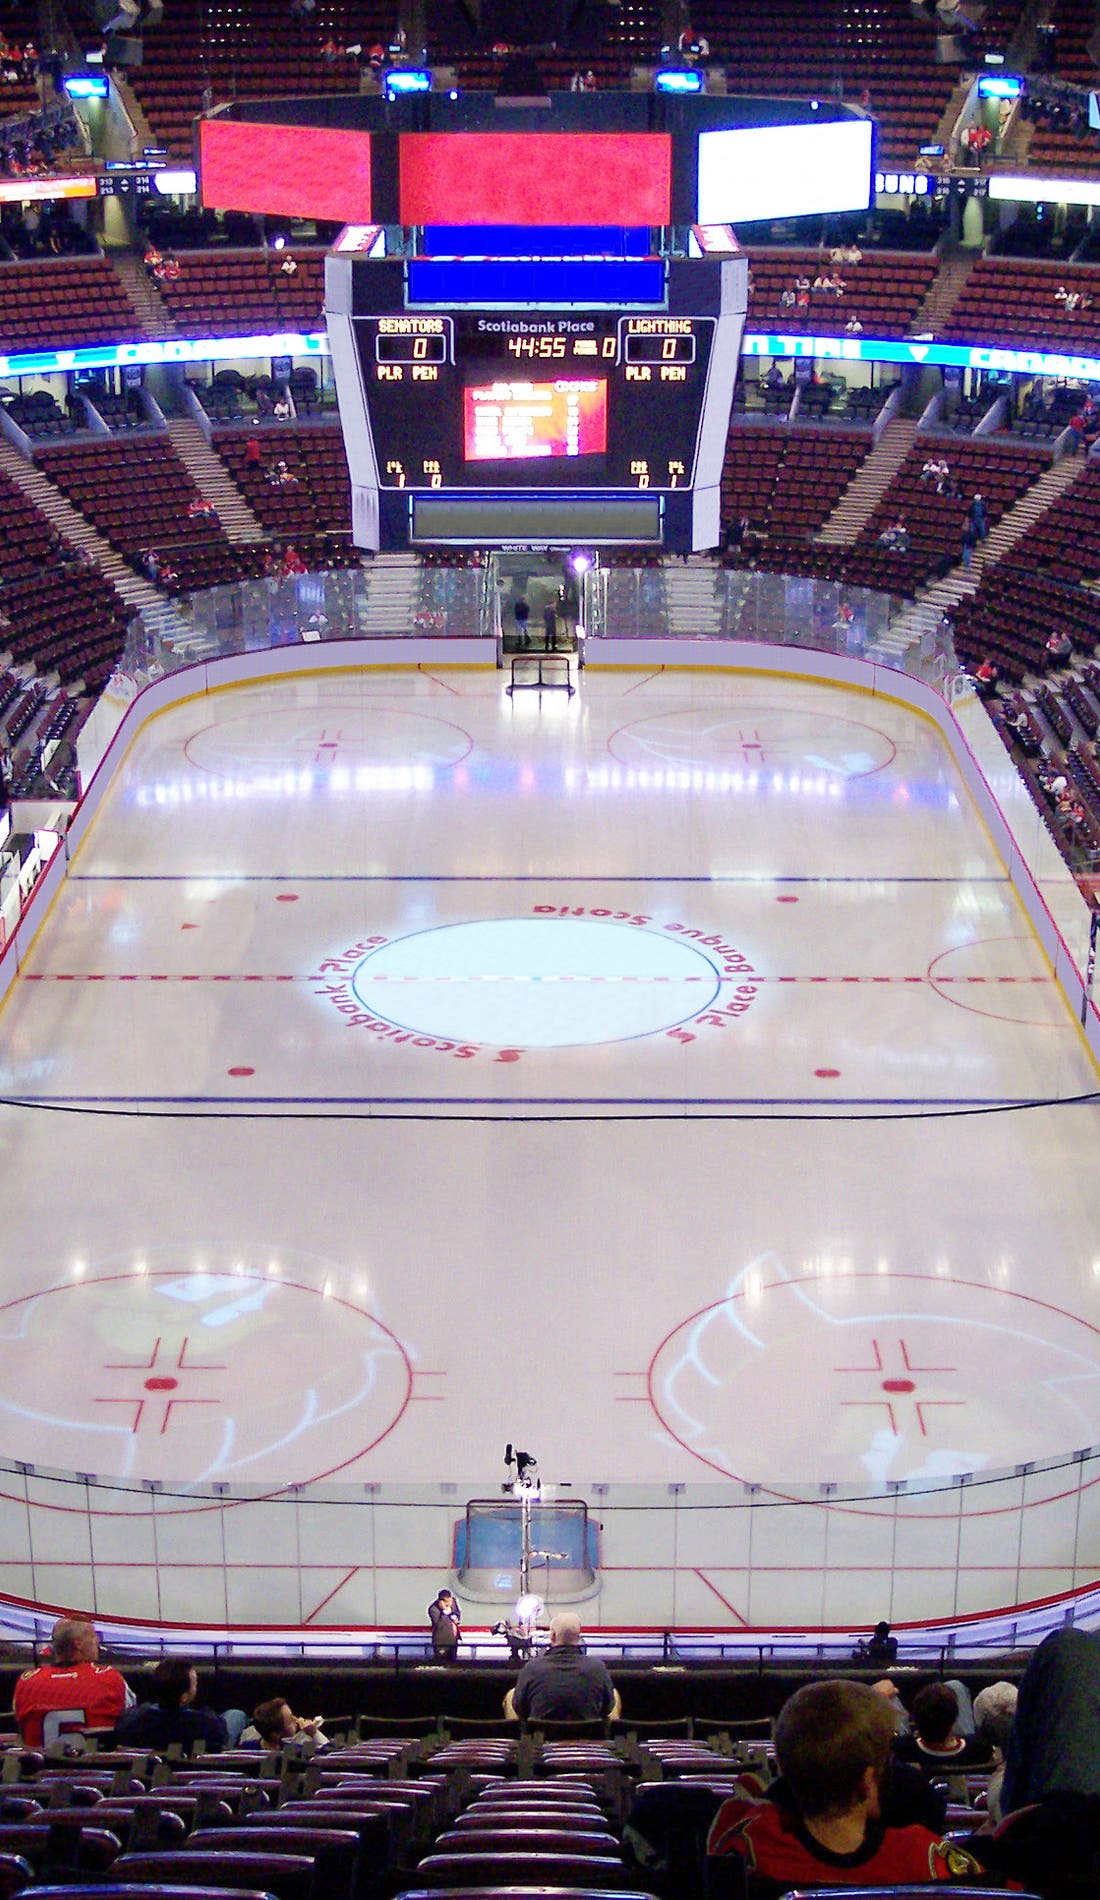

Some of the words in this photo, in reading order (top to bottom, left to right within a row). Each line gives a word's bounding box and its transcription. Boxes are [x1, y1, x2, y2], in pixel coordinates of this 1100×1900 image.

[378, 319, 444, 334] SENATORS
[478, 319, 555, 334] Scotiabank
[558, 320, 596, 333] Place
[413, 337, 428, 359] 0
[508, 337, 567, 358] 44:55
[601, 337, 617, 358] 0
[662, 337, 677, 359] 0
[377, 365, 403, 381] PLR
[625, 366, 652, 381] PLR
[660, 366, 687, 381] PEN
[533, 905, 652, 926] Scotia
[319, 936, 388, 972] Place
[664, 923, 755, 973] Banque
[695, 985, 758, 1027] Place
[314, 984, 480, 1059] Scotiabank
